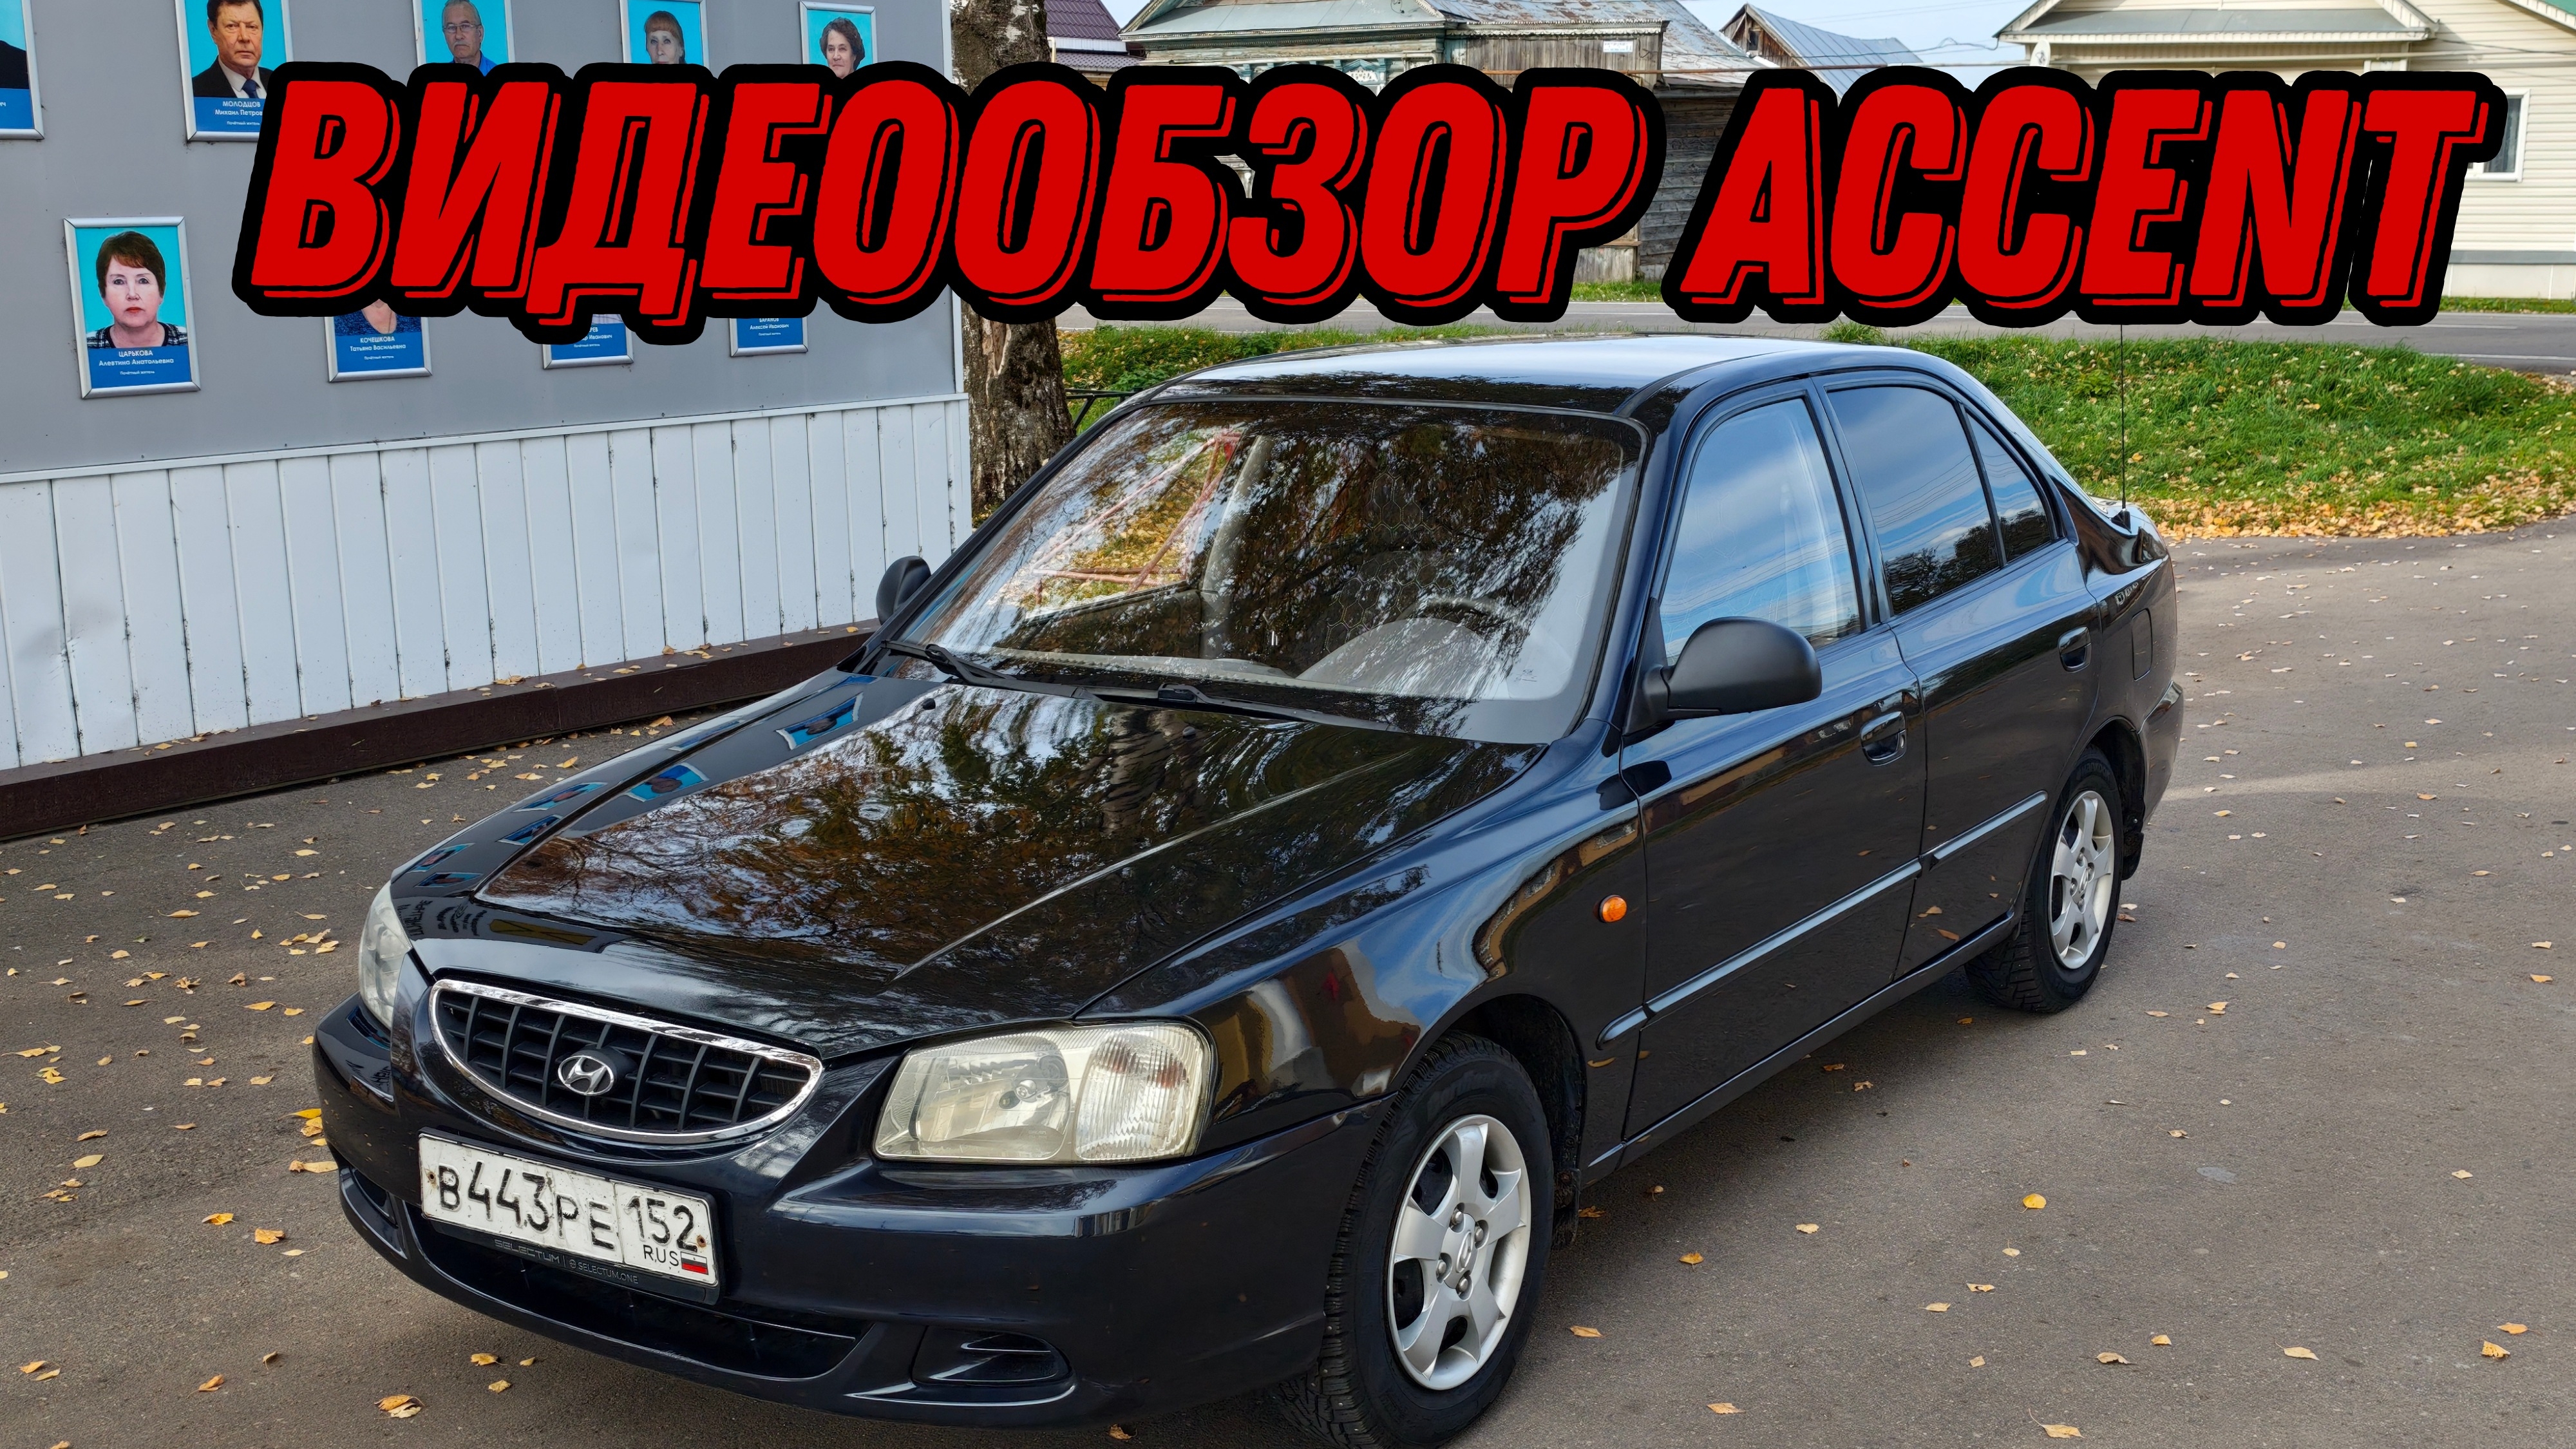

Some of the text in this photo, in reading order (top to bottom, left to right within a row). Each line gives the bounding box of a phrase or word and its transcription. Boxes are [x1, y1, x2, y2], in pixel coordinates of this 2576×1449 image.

[624, 1196, 698, 1253] 152
[494, 1239, 639, 1285] SELECTUM SELECTUM.ONE
[643, 1244, 679, 1267] RUS
